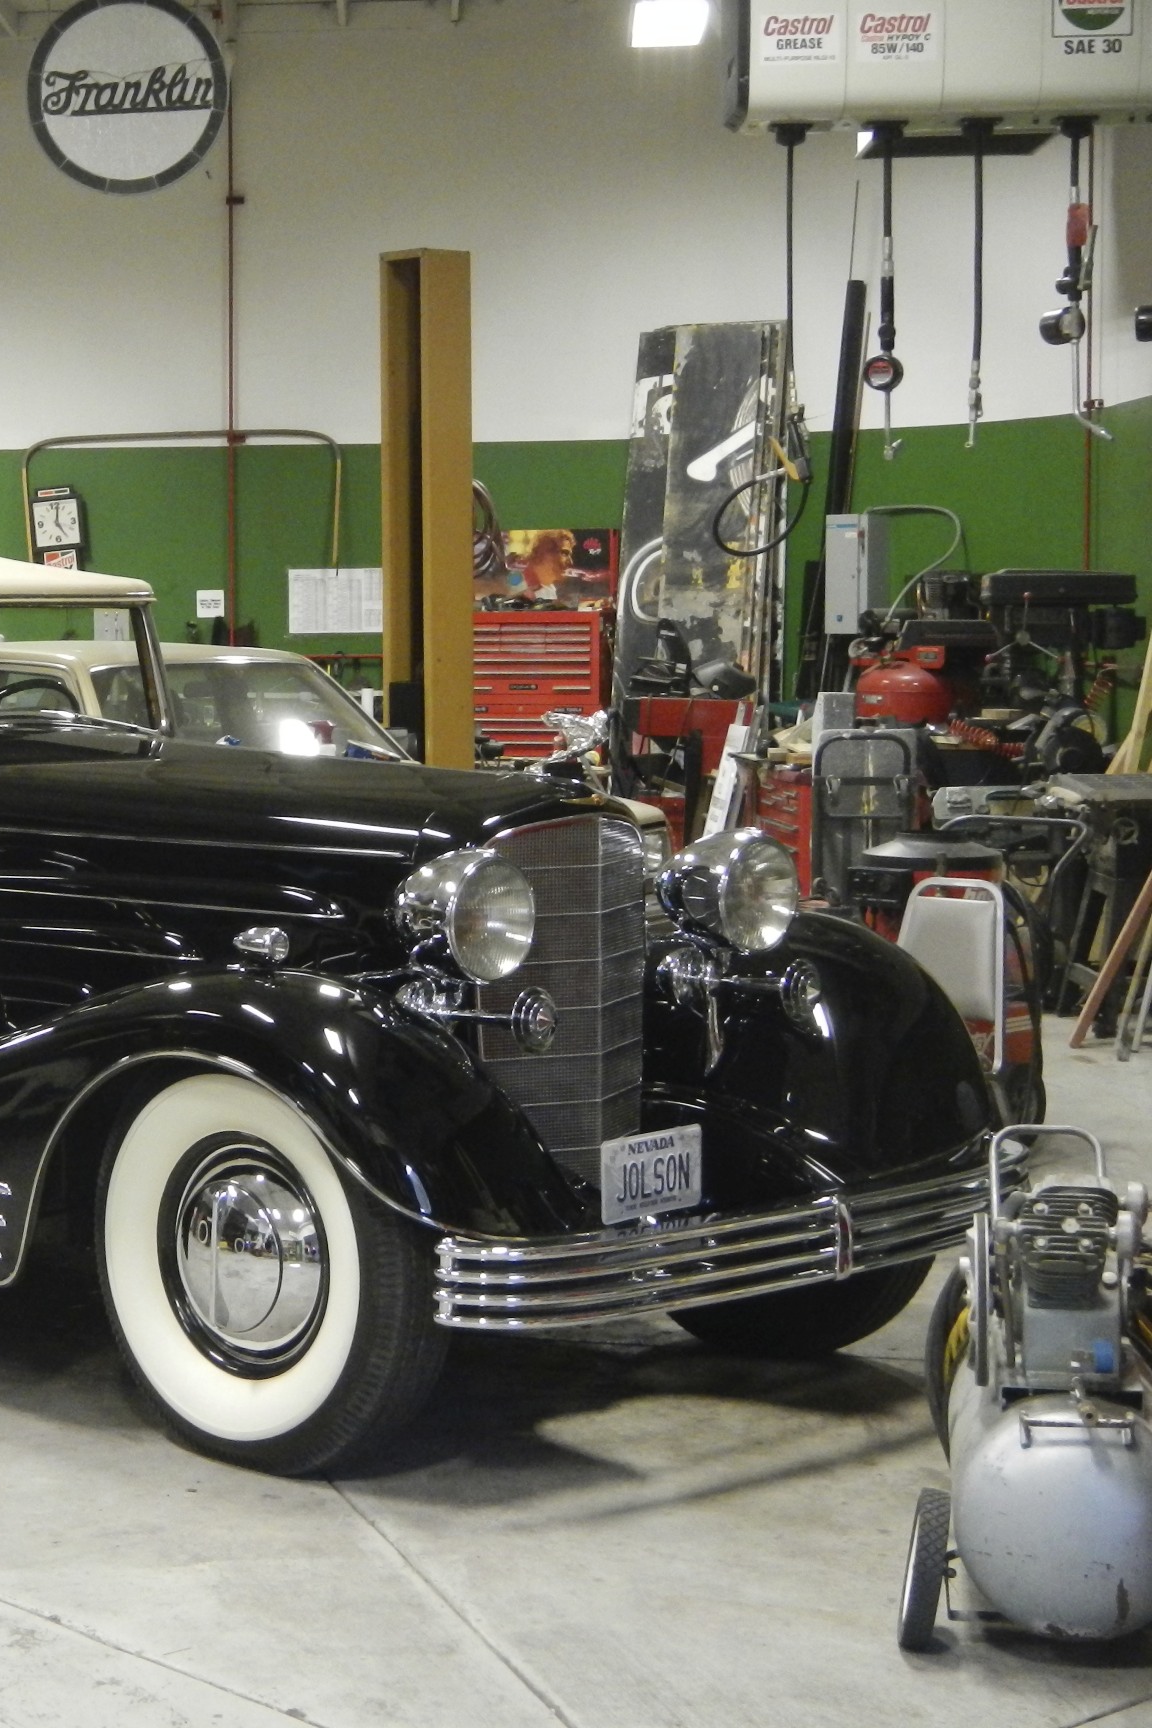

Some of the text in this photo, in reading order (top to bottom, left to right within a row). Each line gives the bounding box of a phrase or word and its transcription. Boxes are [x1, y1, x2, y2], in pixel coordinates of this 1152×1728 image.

[763, 14, 835, 37] Castrol
[860, 12, 931, 34] Castrol
[776, 37, 823, 50] GREASE
[887, 33, 921, 41] HYPOY
[871, 42, 924, 54] 85W/140
[1064, 38, 1122, 55] SAE 30
[43, 63, 214, 116] Franklin
[38, 520, 44, 529] 9
[70, 517, 76, 525] 3
[55, 535, 62, 543] 6
[628, 1136, 675, 1156] NEVADA
[616, 1152, 690, 1203] JOLSON
